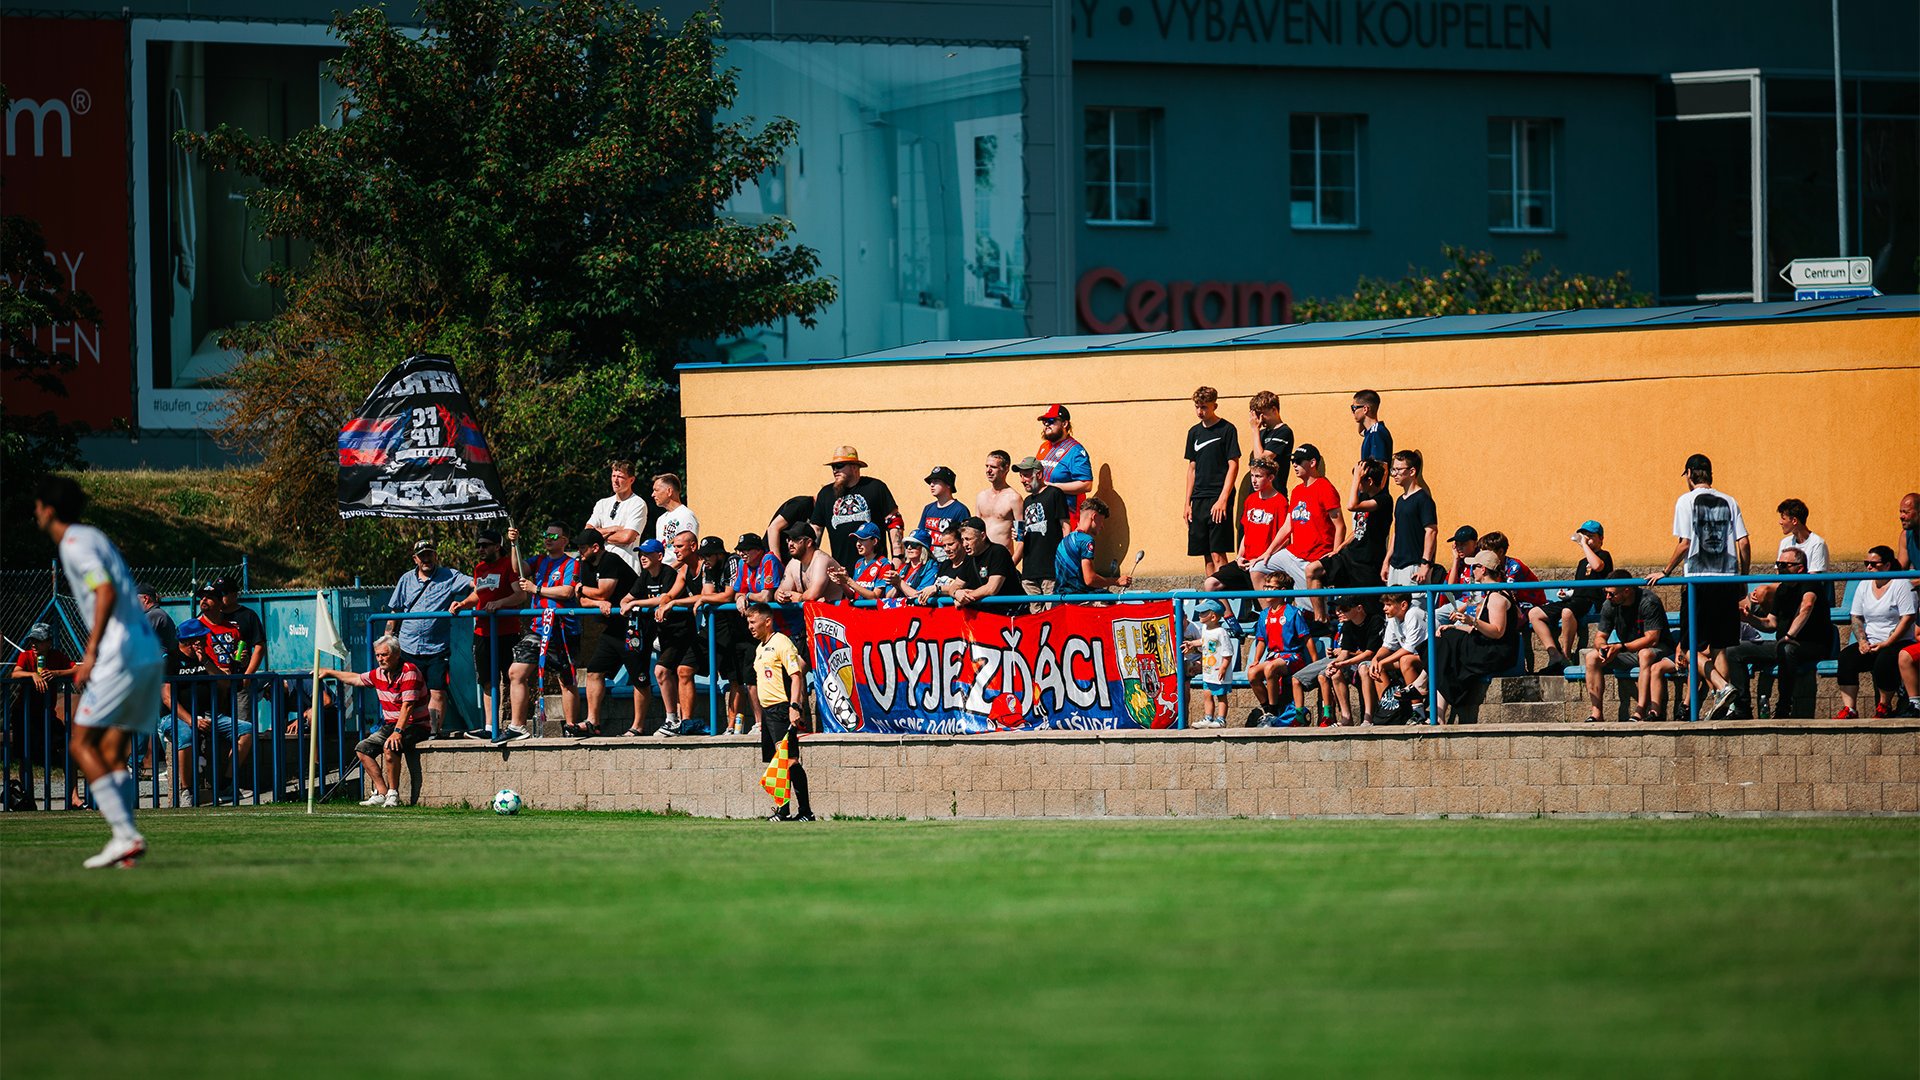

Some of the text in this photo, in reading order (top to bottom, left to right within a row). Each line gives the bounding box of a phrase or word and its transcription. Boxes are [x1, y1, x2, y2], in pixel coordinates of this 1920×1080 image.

[1356, 1, 1551, 50] KOUPELEN
[1804, 267, 1846, 279] Centrum
[1075, 267, 1294, 333] Ceram
[289, 623, 309, 637] Služby
[817, 622, 839, 638] PLZEŇ
